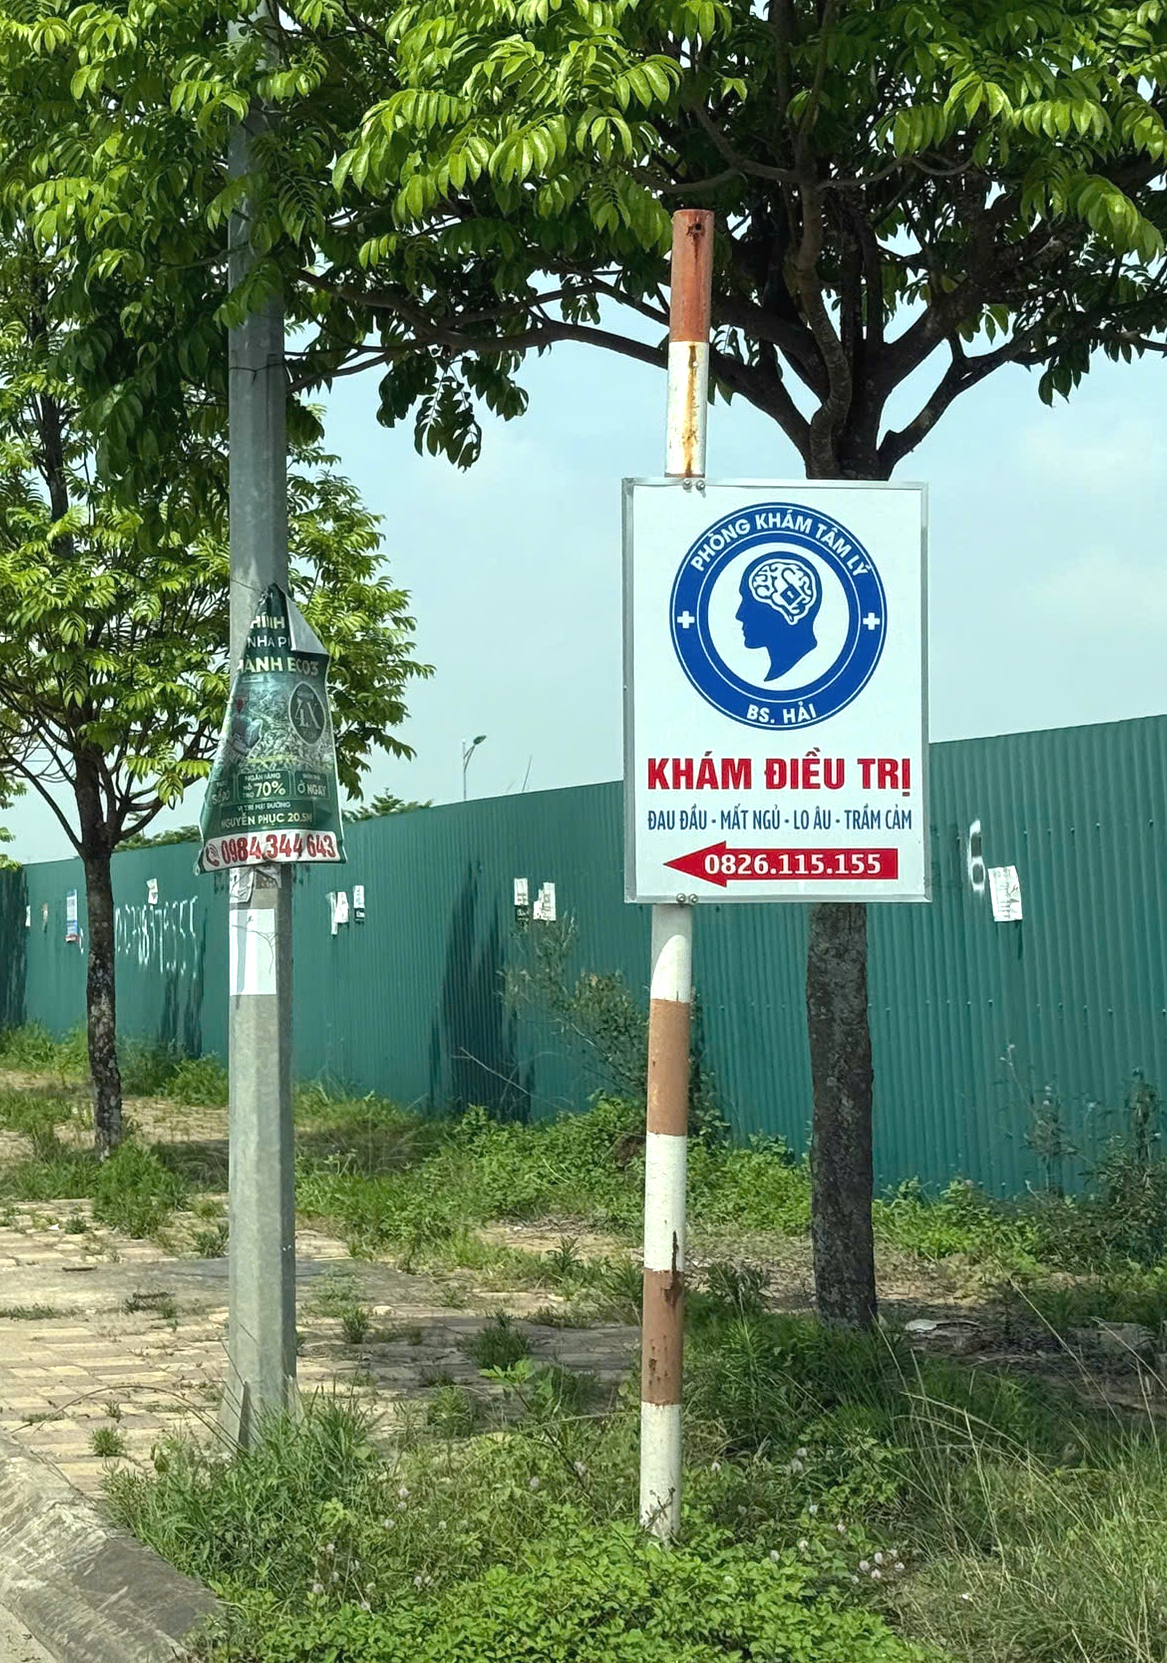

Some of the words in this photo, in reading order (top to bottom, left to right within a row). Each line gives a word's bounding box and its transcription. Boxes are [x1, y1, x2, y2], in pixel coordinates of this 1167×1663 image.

[690, 518, 751, 572] PHÒNG
[755, 510, 813, 534] KHÁM
[815, 522, 852, 560] TÂM
[846, 554, 871, 577] LÝ
[746, 703, 775, 724] BS.
[782, 701, 818, 724] HẢI
[647, 750, 752, 790] KHÁM
[763, 746, 845, 790] ĐIỀU
[856, 757, 911, 798] TRỊ
[254, 780, 287, 798] 70%
[647, 809, 676, 831] ĐAU
[720, 802, 749, 831] MẤT
[752, 803, 781, 831] NGỦ
[793, 809, 810, 830] LO
[813, 805, 832, 830] ÂU
[885, 803, 912, 830] CẢM
[704, 853, 882, 875] 0826.115.155
